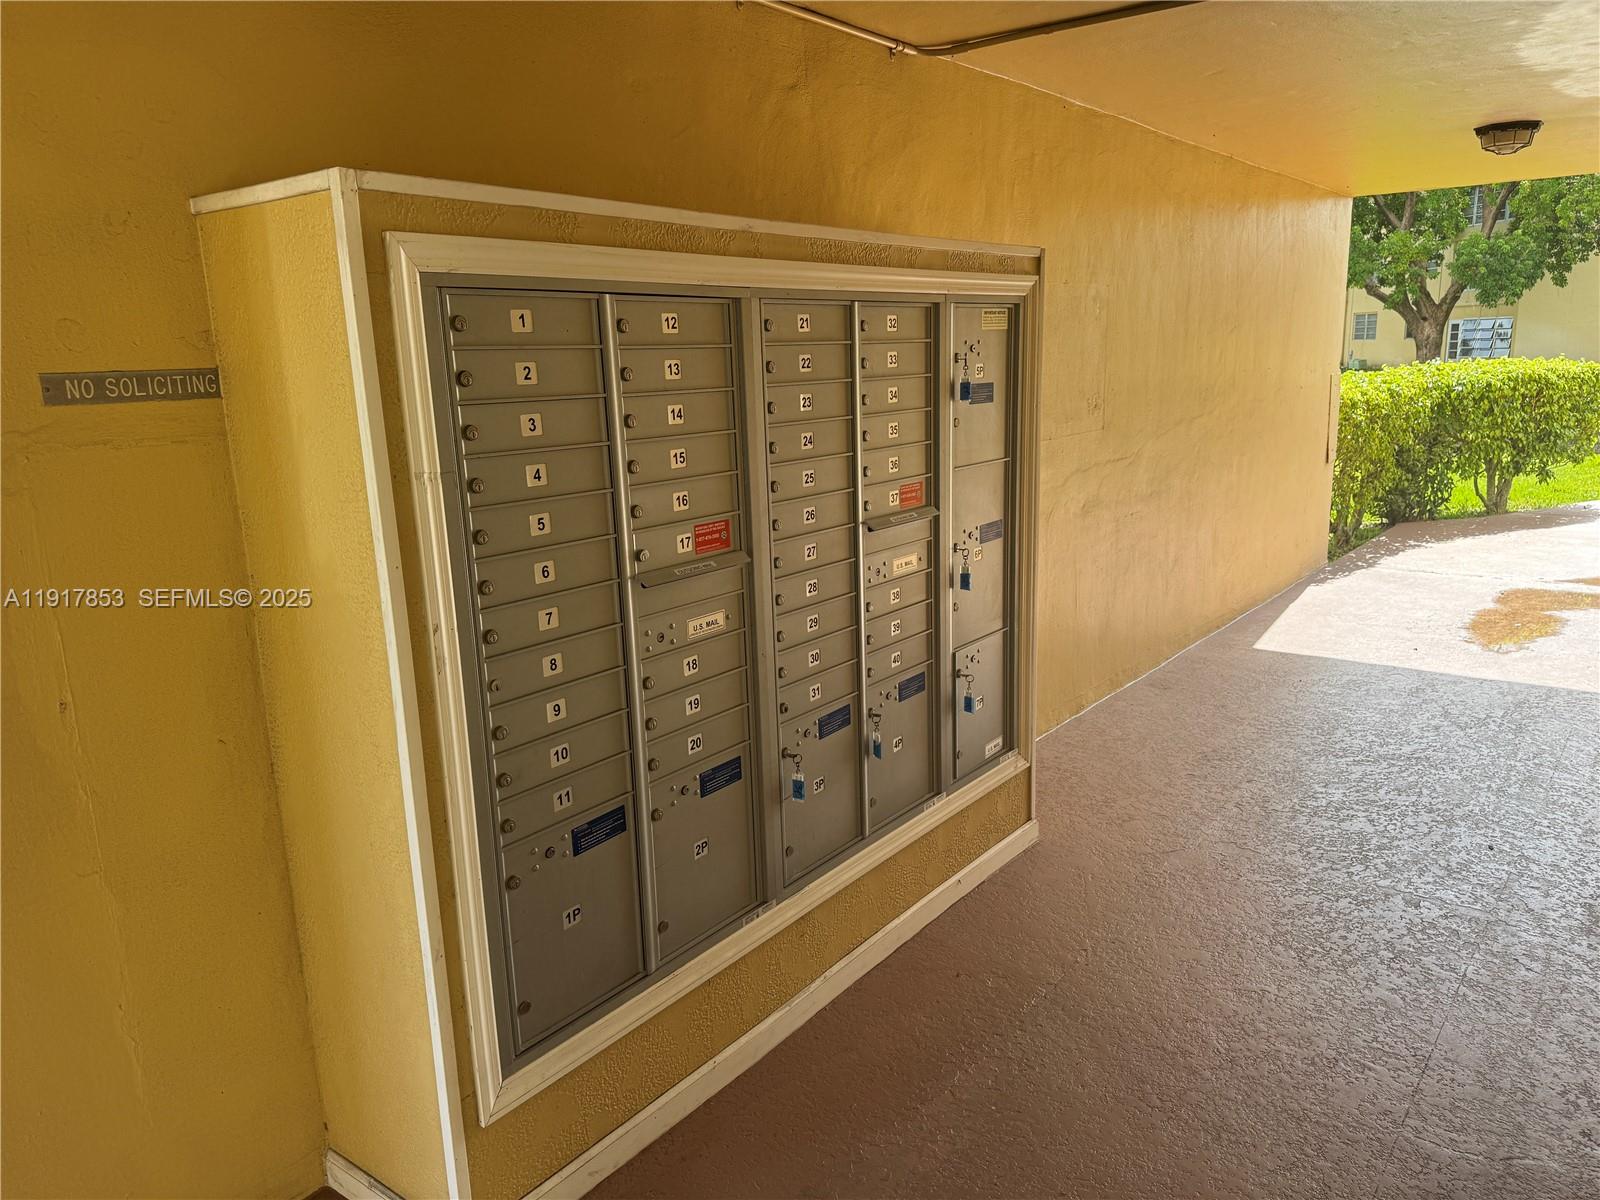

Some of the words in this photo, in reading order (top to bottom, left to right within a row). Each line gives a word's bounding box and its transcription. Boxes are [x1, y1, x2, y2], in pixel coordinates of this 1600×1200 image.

[519, 313, 525, 328] 1
[665, 316, 677, 329] 12
[799, 317, 809, 329] 21
[888, 318, 897, 328] 32
[801, 357, 811, 369] 22
[889, 354, 897, 364] 33
[523, 366, 532, 380] 2
[668, 363, 680, 376] 13
[65, 378, 95, 399] NO
[105, 374, 218, 397] SOLICITING
[889, 390, 898, 400] 34
[802, 397, 812, 408] 23
[671, 408, 683, 420] 14
[528, 418, 536, 432] 3
[890, 425, 898, 435] 35
[803, 435, 813, 447] 24
[673, 452, 685, 464] 15
[890, 460, 898, 470] 36
[533, 468, 542, 482] 4
[804, 472, 815, 484] 25
[676, 495, 688, 507] 16
[890, 493, 898, 503] 37
[805, 509, 815, 521] 26
[538, 517, 545, 531] 5
[680, 536, 691, 549] 17
[807, 546, 816, 558] 27
[542, 565, 550, 578] 6
[808, 582, 818, 593] 28
[891, 591, 900, 601] 38
[545, 612, 552, 625] 7
[809, 617, 818, 629] 29
[693, 623, 704, 632] U.S.
[705, 618, 720, 628] MAIL
[892, 622, 900, 633] 39
[810, 652, 820, 664] 30
[892, 654, 901, 664] 40
[550, 658, 557, 671] 8
[686, 658, 697, 672] 18
[811, 686, 820, 698] 31
[553, 704, 561, 717] 9
[688, 698, 699, 711] 19
[690, 737, 701, 751] 20
[893, 738, 903, 749] 4P
[554, 747, 568, 762] 10
[814, 778, 824, 791] 3P
[557, 790, 570, 806] 11
[695, 841, 708, 856] 2P
[565, 908, 581, 924] 1P
